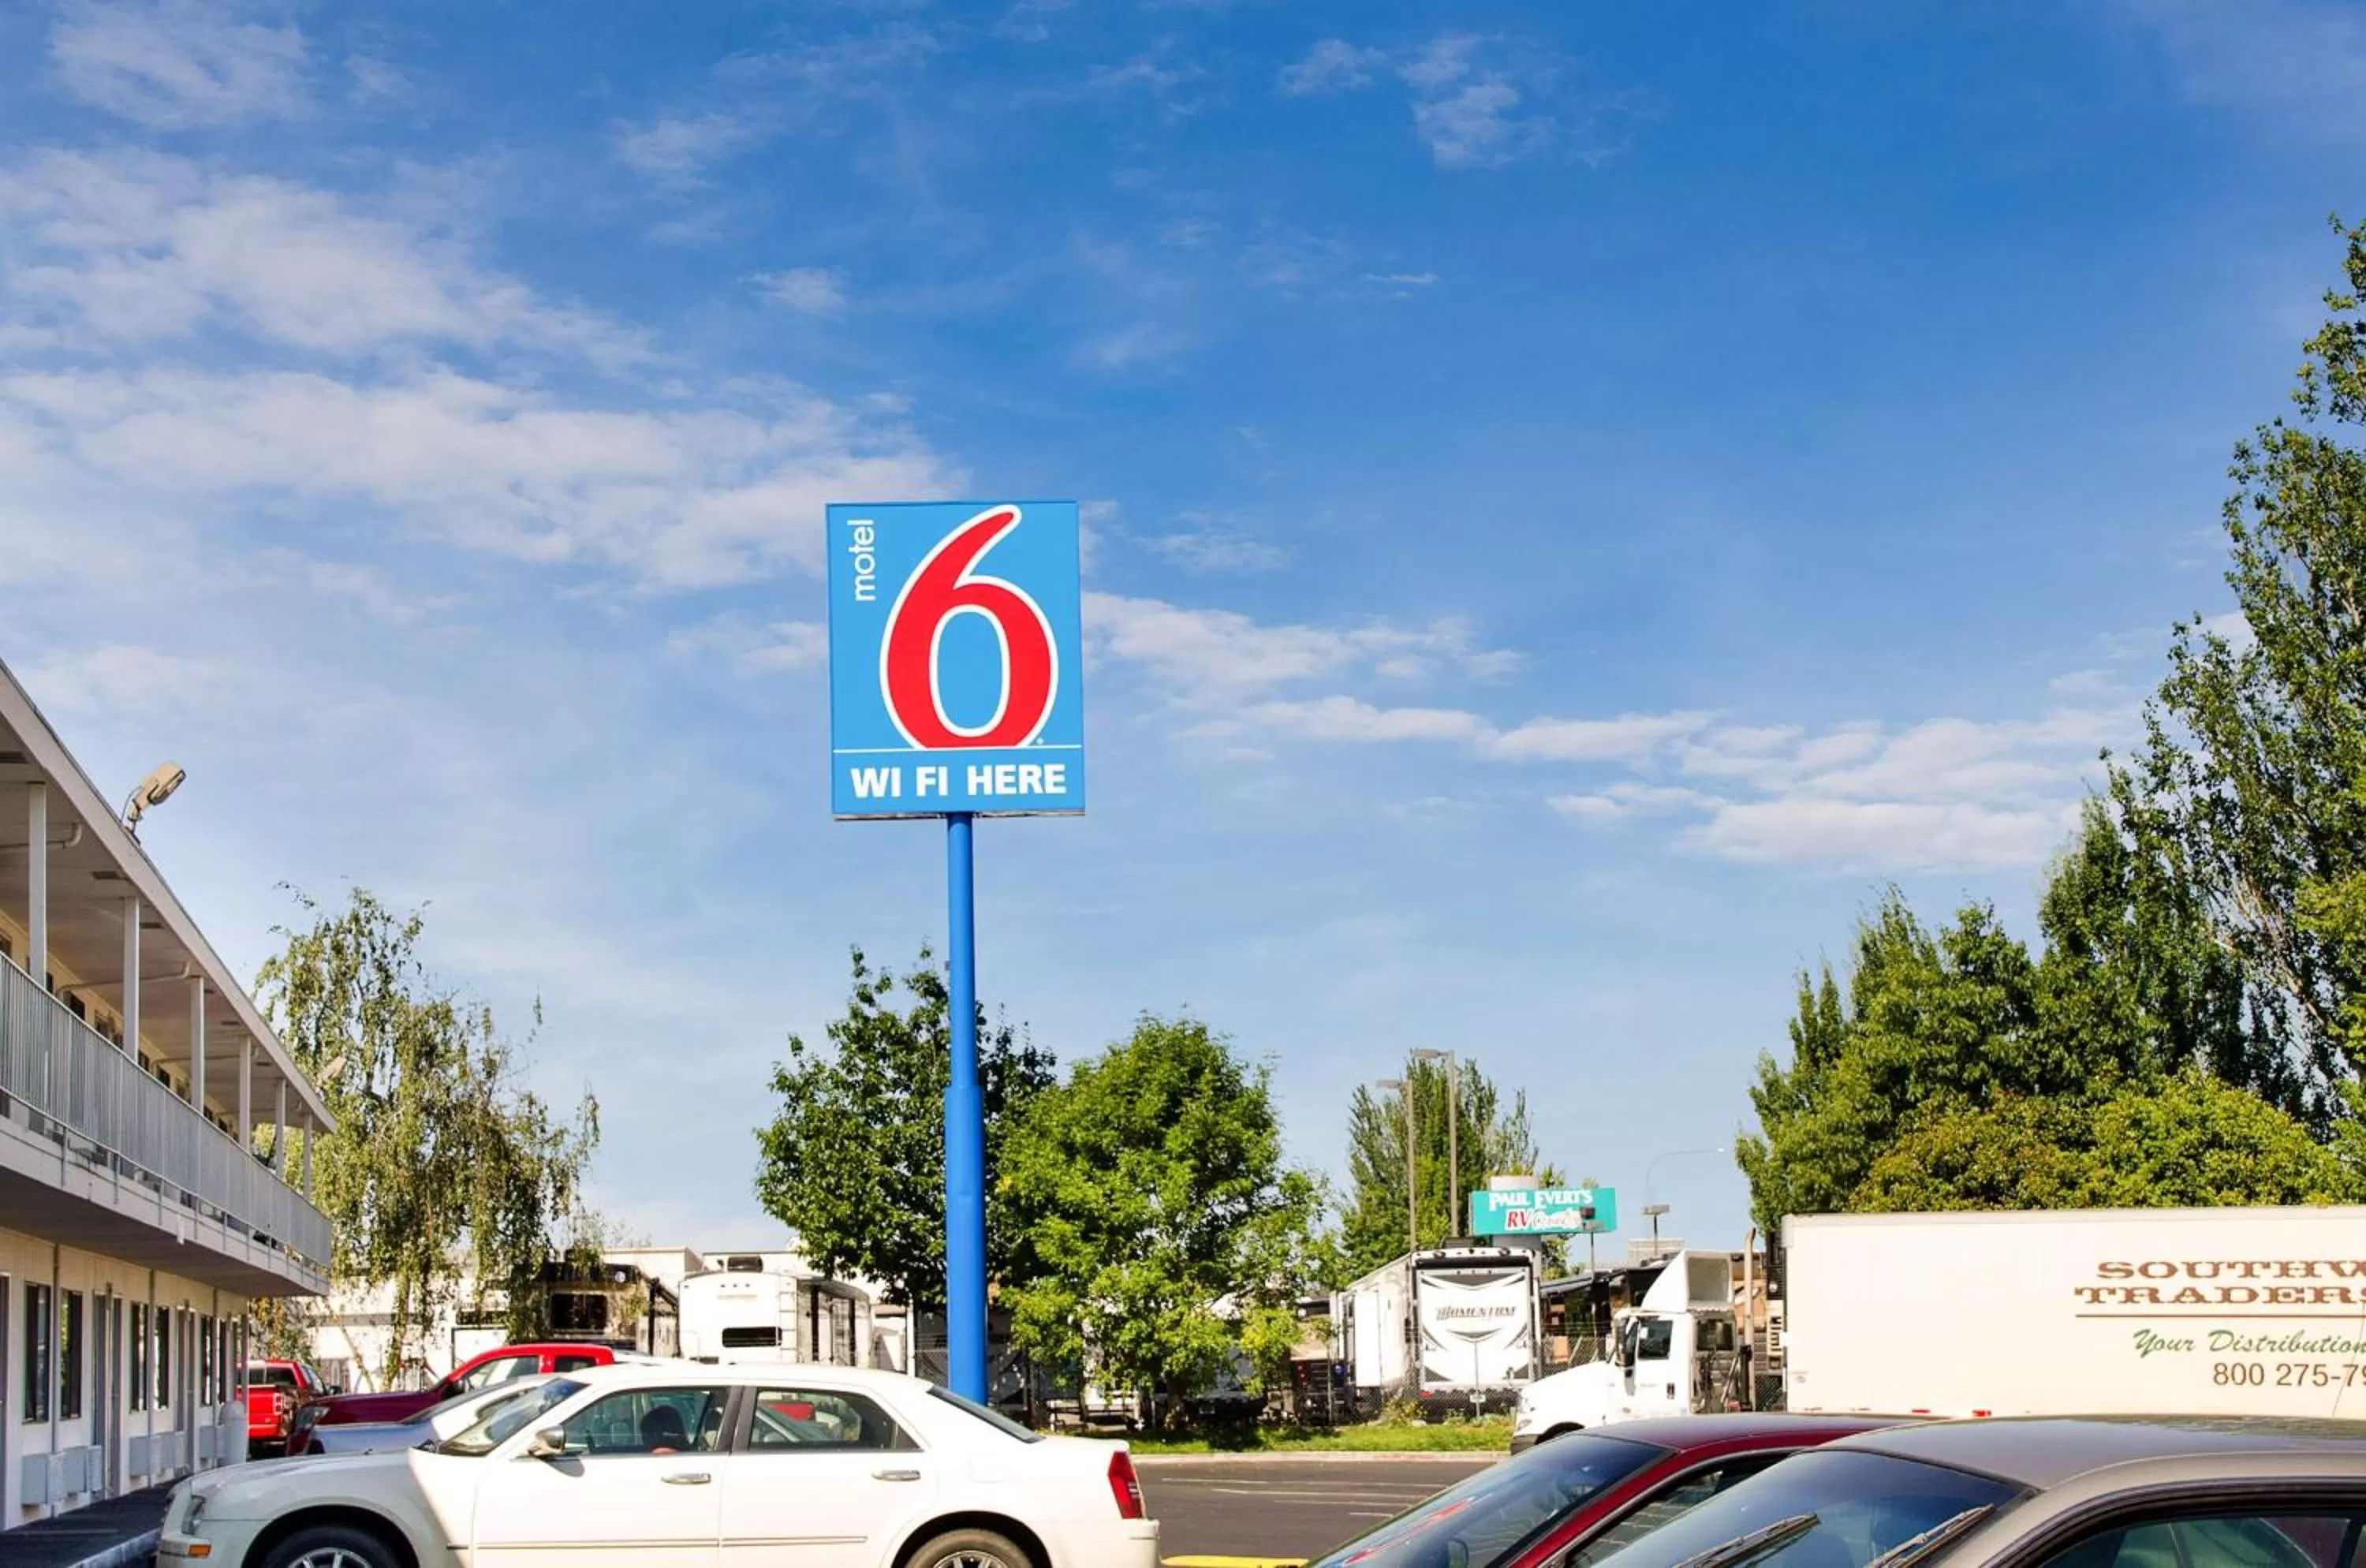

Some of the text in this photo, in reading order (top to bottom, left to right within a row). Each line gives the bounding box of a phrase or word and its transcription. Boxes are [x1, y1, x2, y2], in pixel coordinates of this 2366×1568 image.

[846, 519, 876, 601] motel
[879, 504, 1058, 749] 6
[851, 763, 1066, 798] WI FI HERE
[1488, 1192, 1531, 1211] PAUL
[2074, 1286, 2366, 1304] TRADER
[2133, 1329, 2196, 1358] Your
[2214, 1363, 2366, 1387] 800 275-7
